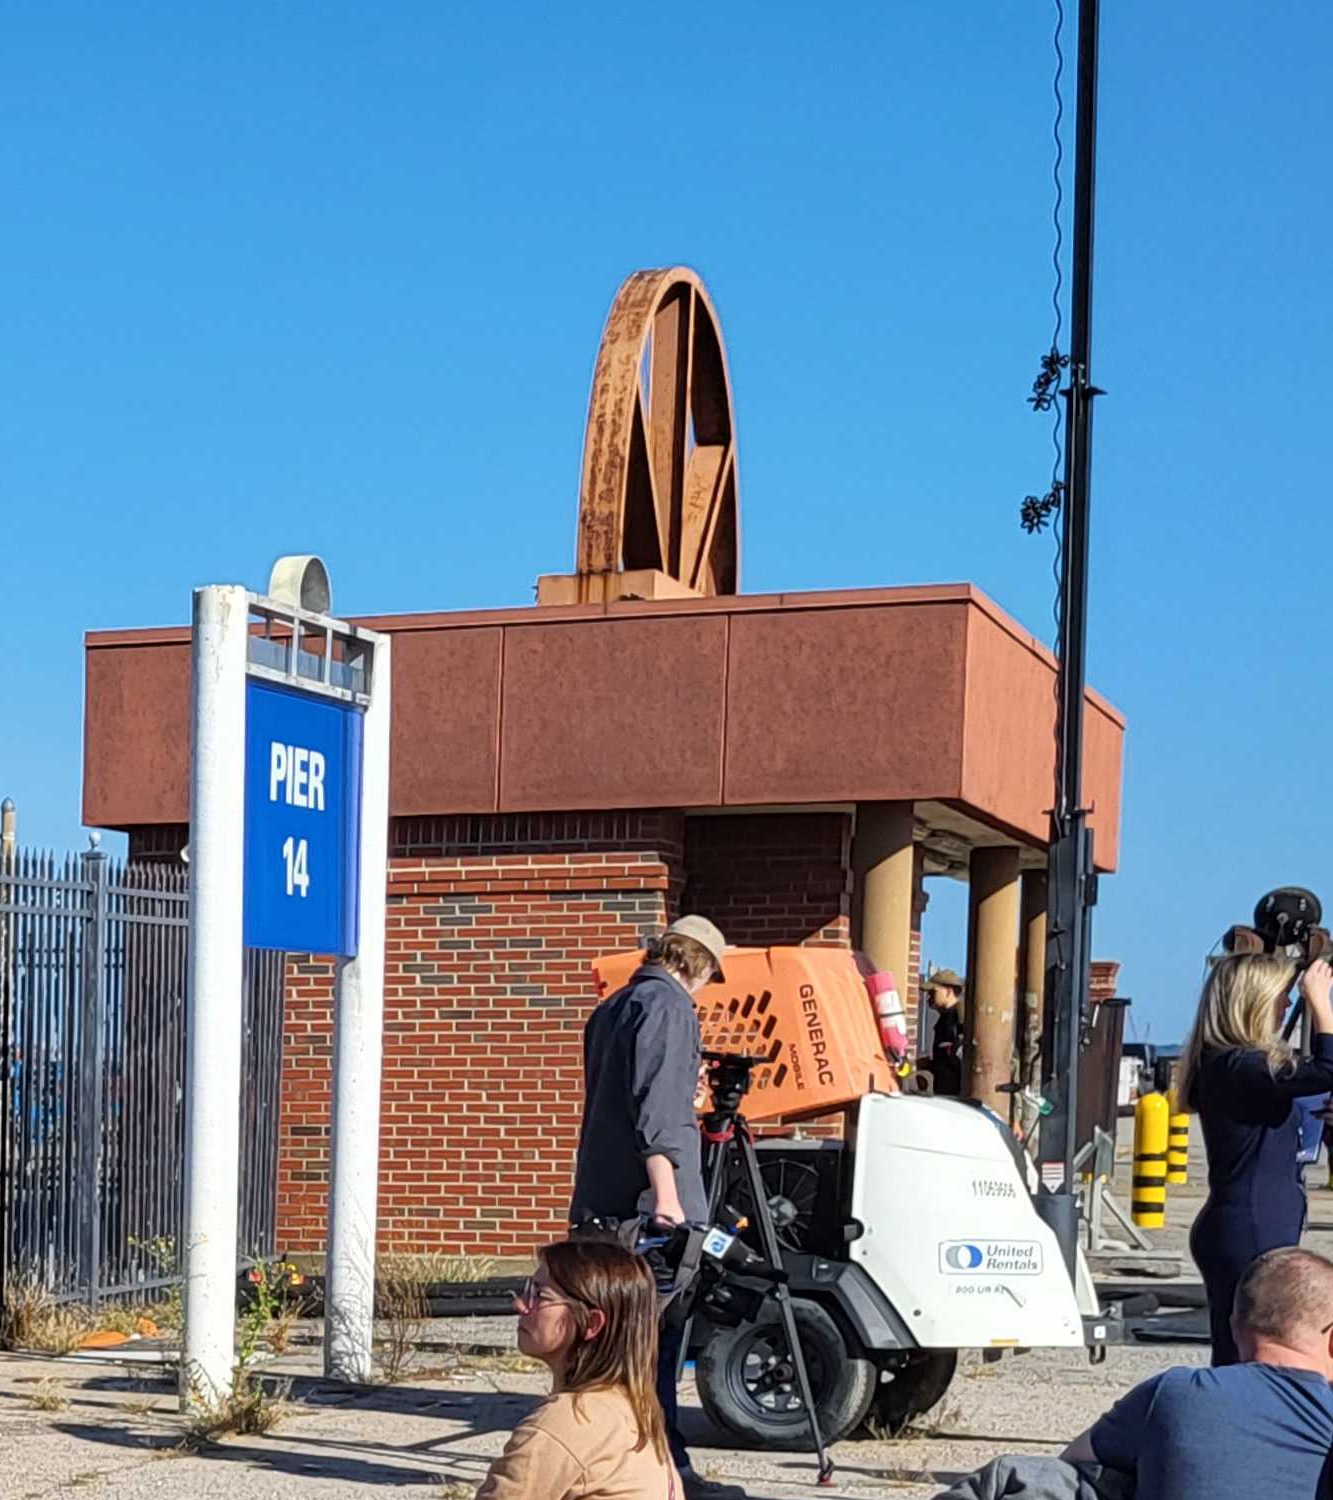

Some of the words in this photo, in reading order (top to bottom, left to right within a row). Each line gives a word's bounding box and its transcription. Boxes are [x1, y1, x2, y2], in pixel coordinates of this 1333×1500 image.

[269, 741, 326, 812] PIER
[282, 836, 310, 898] 14
[799, 983, 834, 1086] GENERAC
[788, 1043, 805, 1091] MOBILE
[986, 1244, 1034, 1258] United
[986, 1258, 1038, 1271] Rentals
